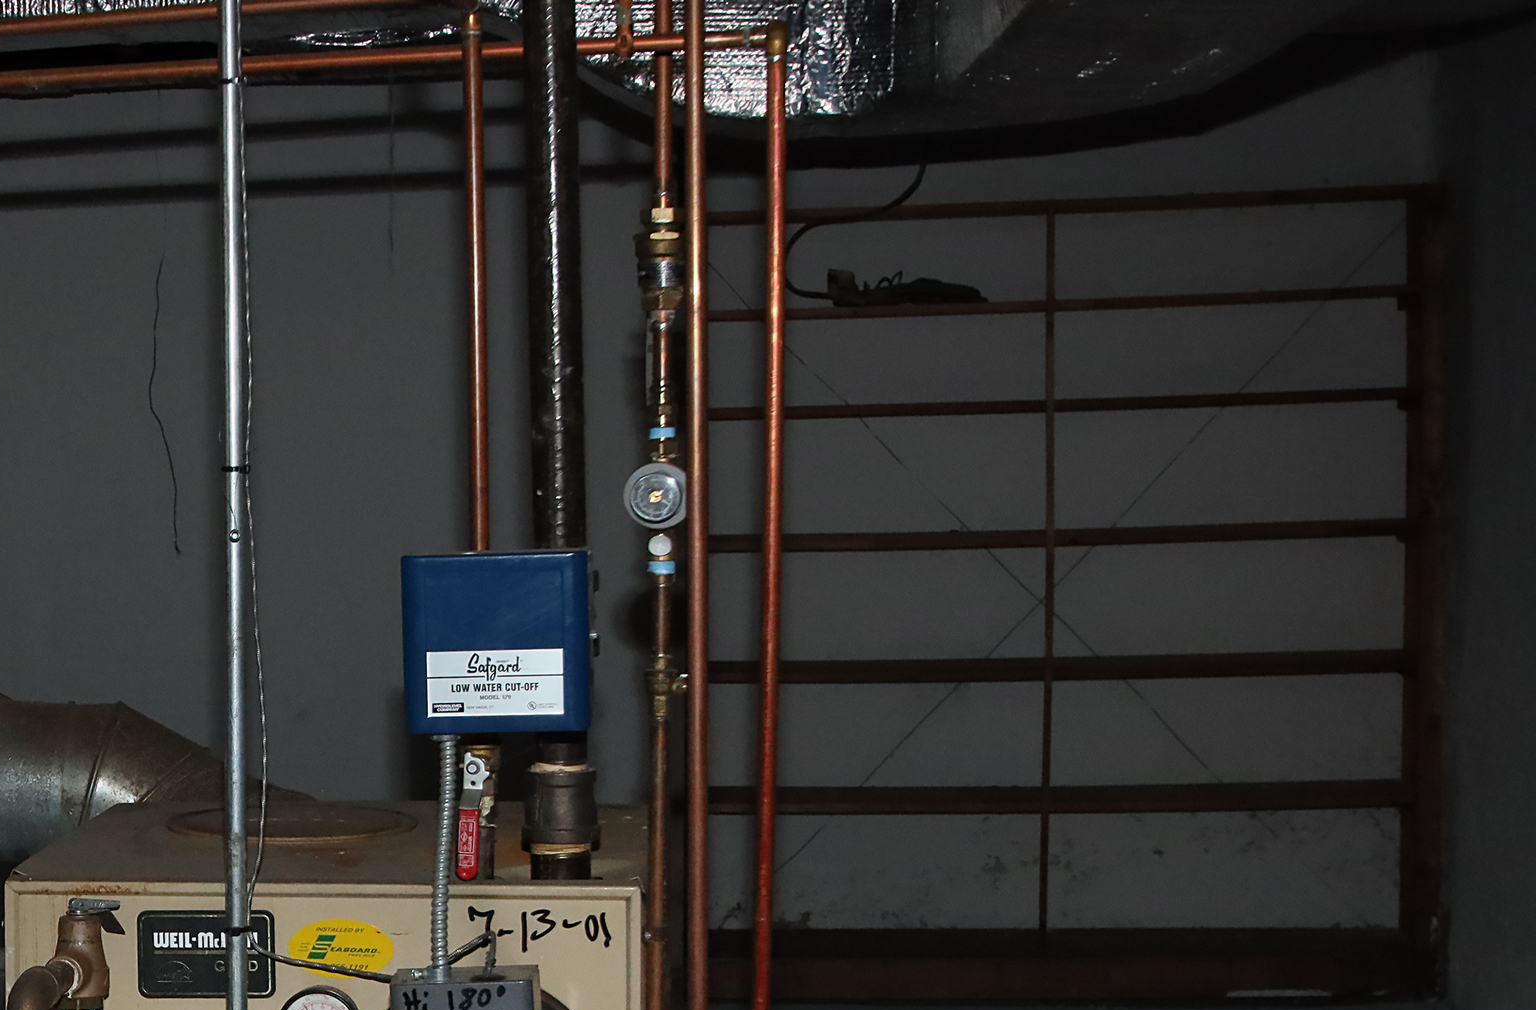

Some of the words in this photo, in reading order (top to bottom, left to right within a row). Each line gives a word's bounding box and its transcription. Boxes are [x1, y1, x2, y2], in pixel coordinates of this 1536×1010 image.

[467, 653, 521, 681] Safgard
[451, 684, 470, 693] LOW
[473, 683, 502, 692] WATER
[505, 682, 539, 691] CUT-OFF
[214, 960, 259, 972] GD
